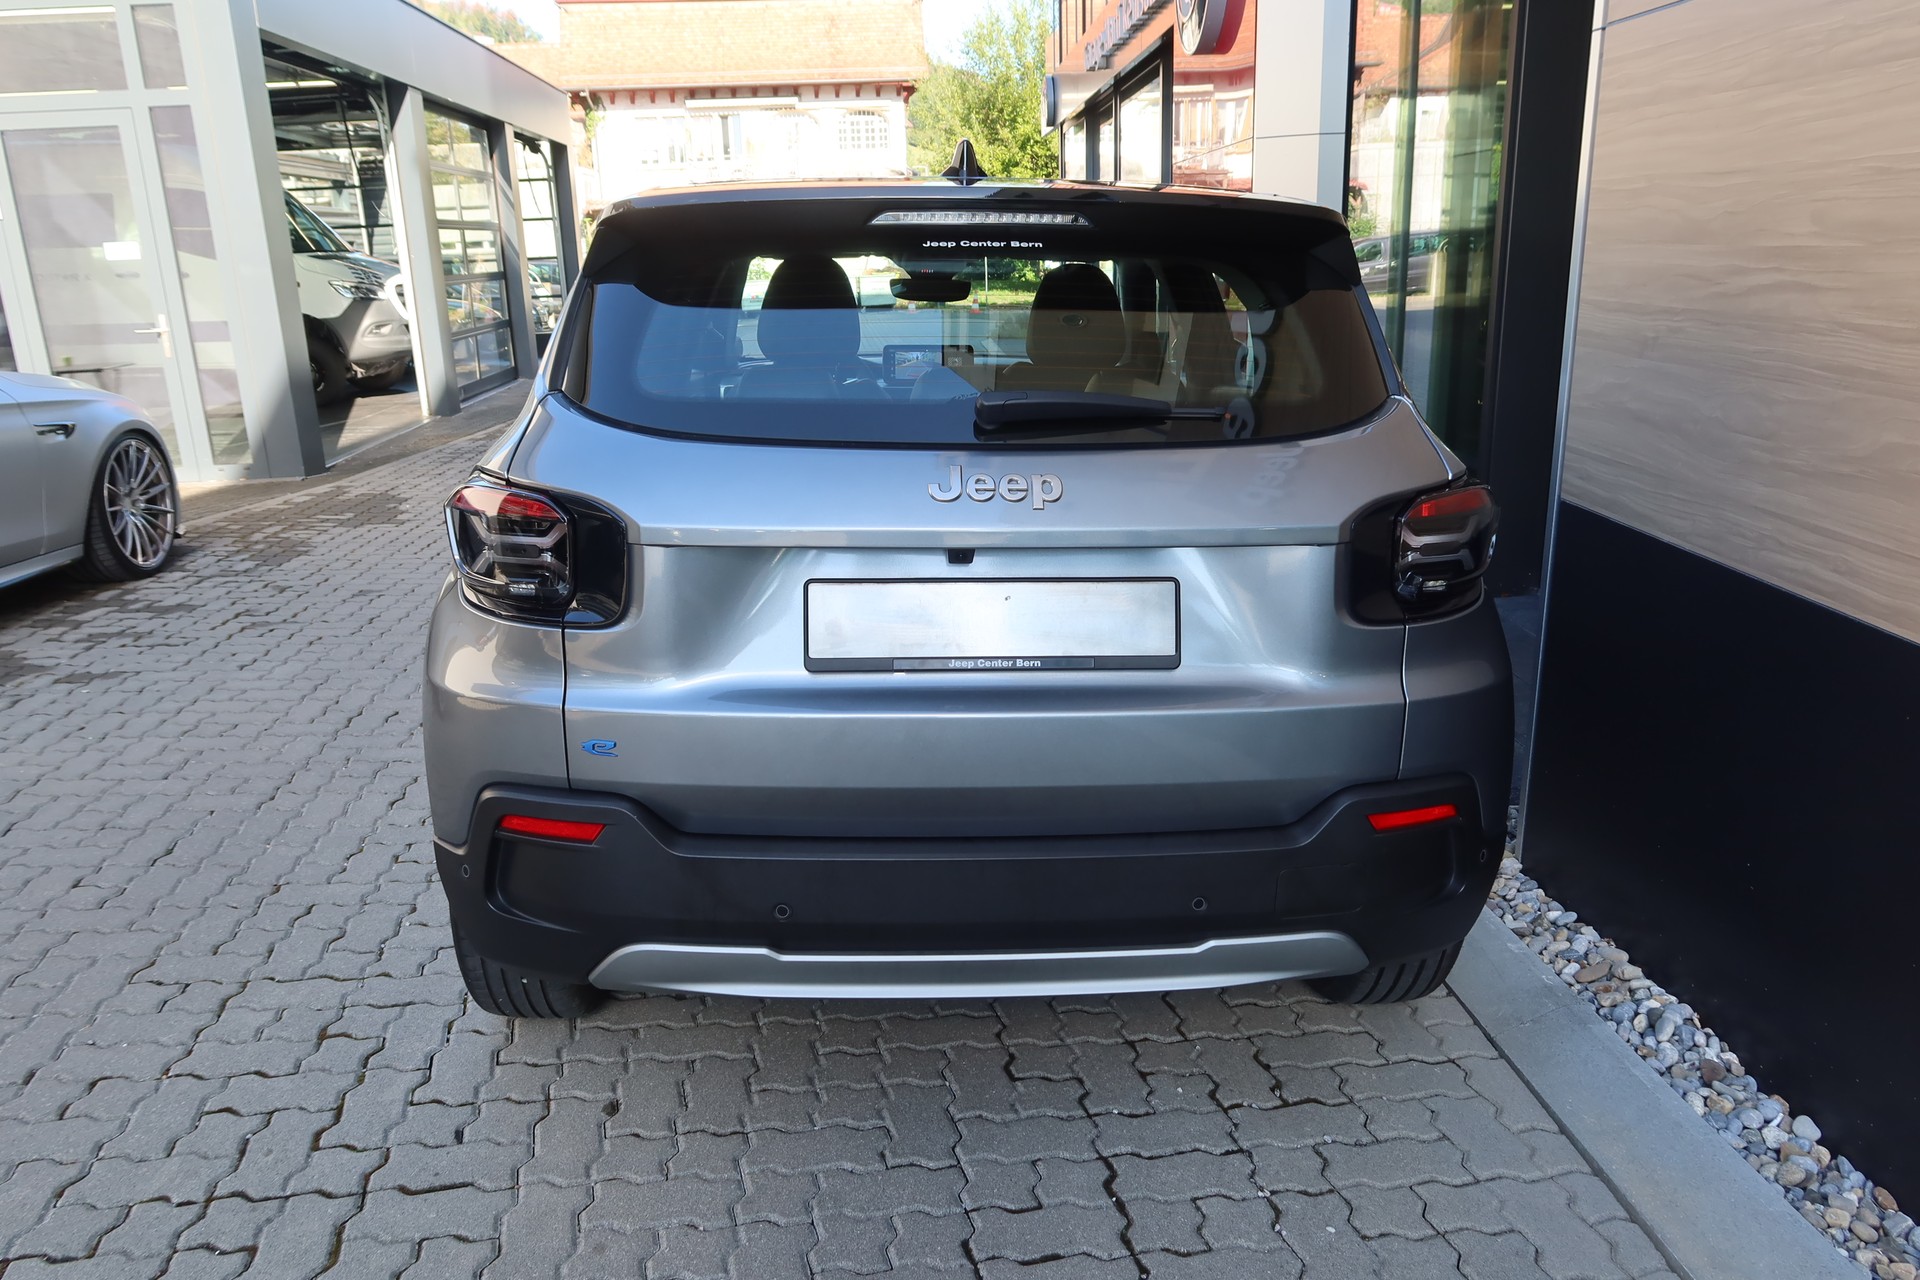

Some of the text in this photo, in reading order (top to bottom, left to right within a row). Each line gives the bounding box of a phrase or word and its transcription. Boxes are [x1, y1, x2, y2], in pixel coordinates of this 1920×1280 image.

[922, 240, 956, 248] Jeep
[1010, 240, 1043, 248] Bern
[927, 464, 1063, 510] Jeep
[948, 658, 1041, 669] Jeep Center Bern
